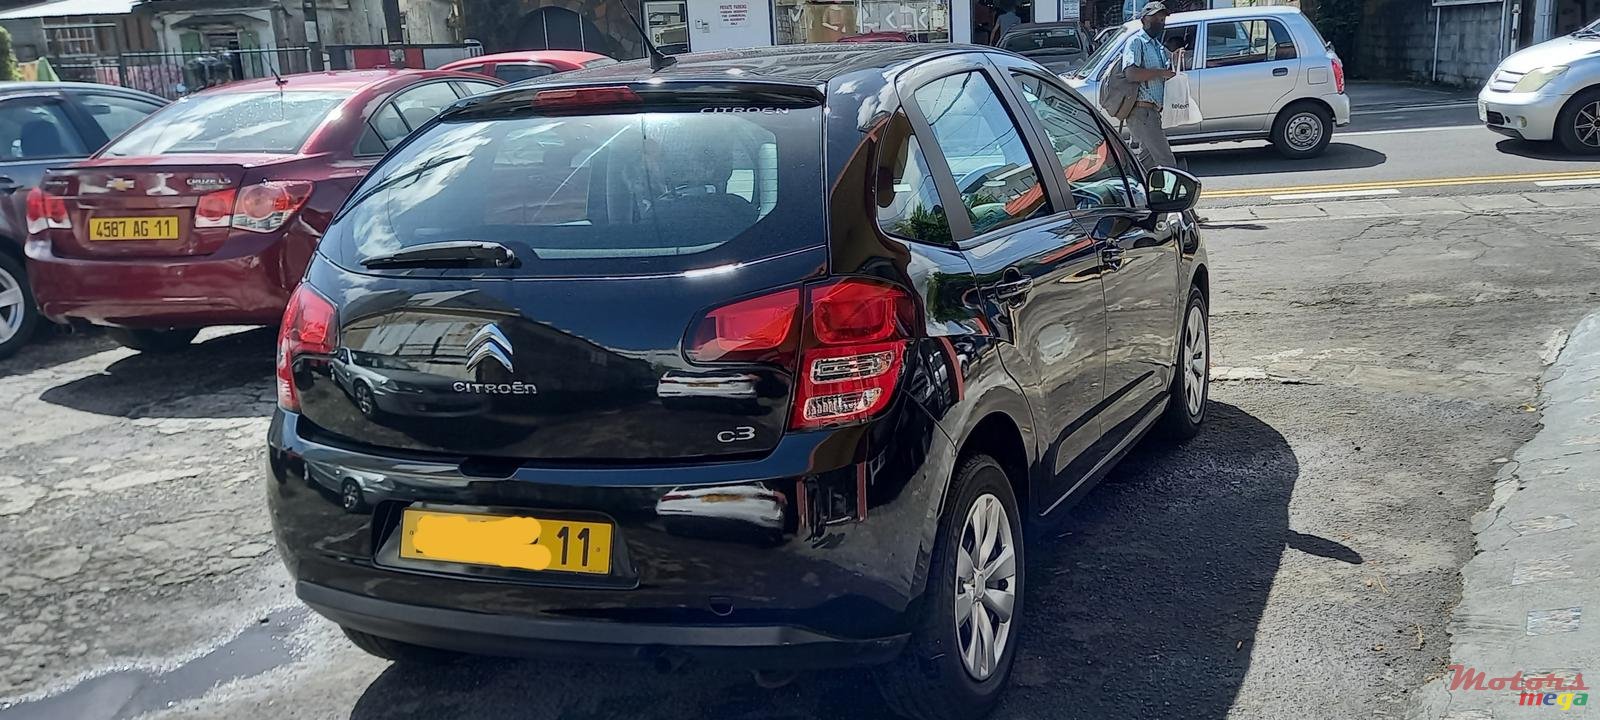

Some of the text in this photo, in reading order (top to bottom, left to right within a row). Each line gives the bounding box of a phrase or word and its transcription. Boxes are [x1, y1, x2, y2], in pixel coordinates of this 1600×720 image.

[186, 177, 232, 186] CRUZE LS
[95, 220, 171, 238] 4587 AG 11
[556, 526, 590, 568] 11
